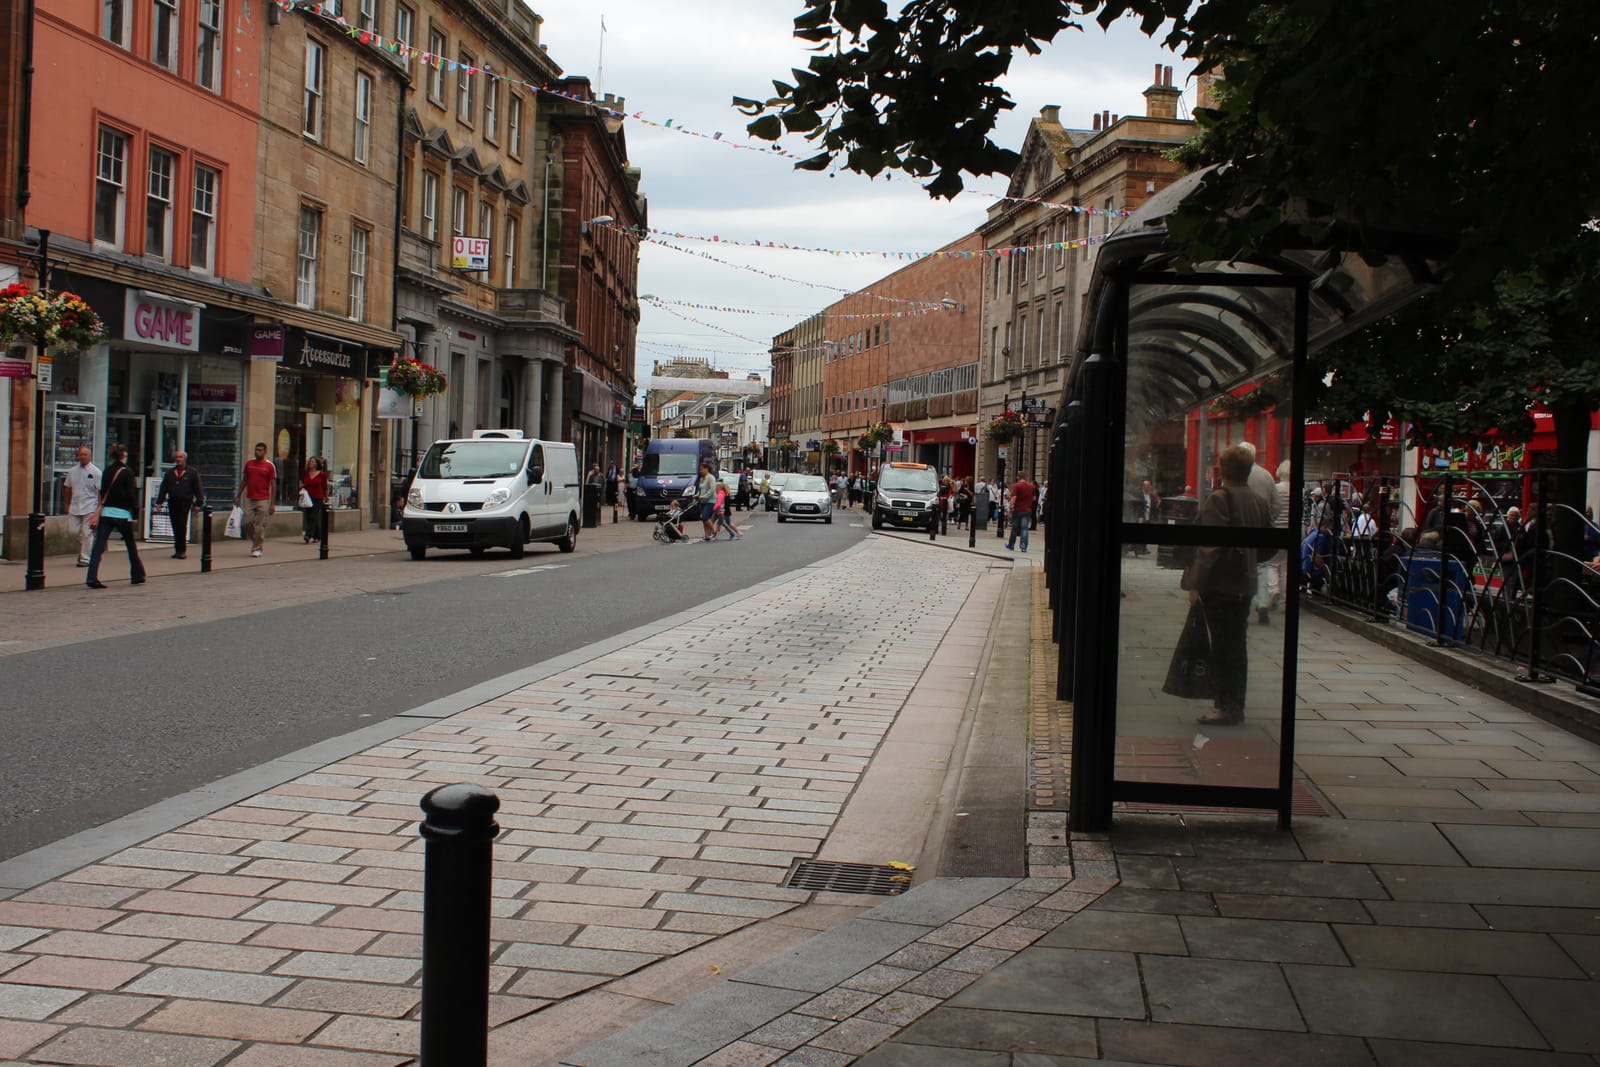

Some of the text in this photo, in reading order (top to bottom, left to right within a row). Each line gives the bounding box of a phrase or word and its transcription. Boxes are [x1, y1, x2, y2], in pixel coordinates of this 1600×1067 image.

[468, 240, 488, 256] LET
[135, 303, 193, 346] GAME
[254, 330, 282, 340] GAME
[299, 336, 351, 368] Accessorize
